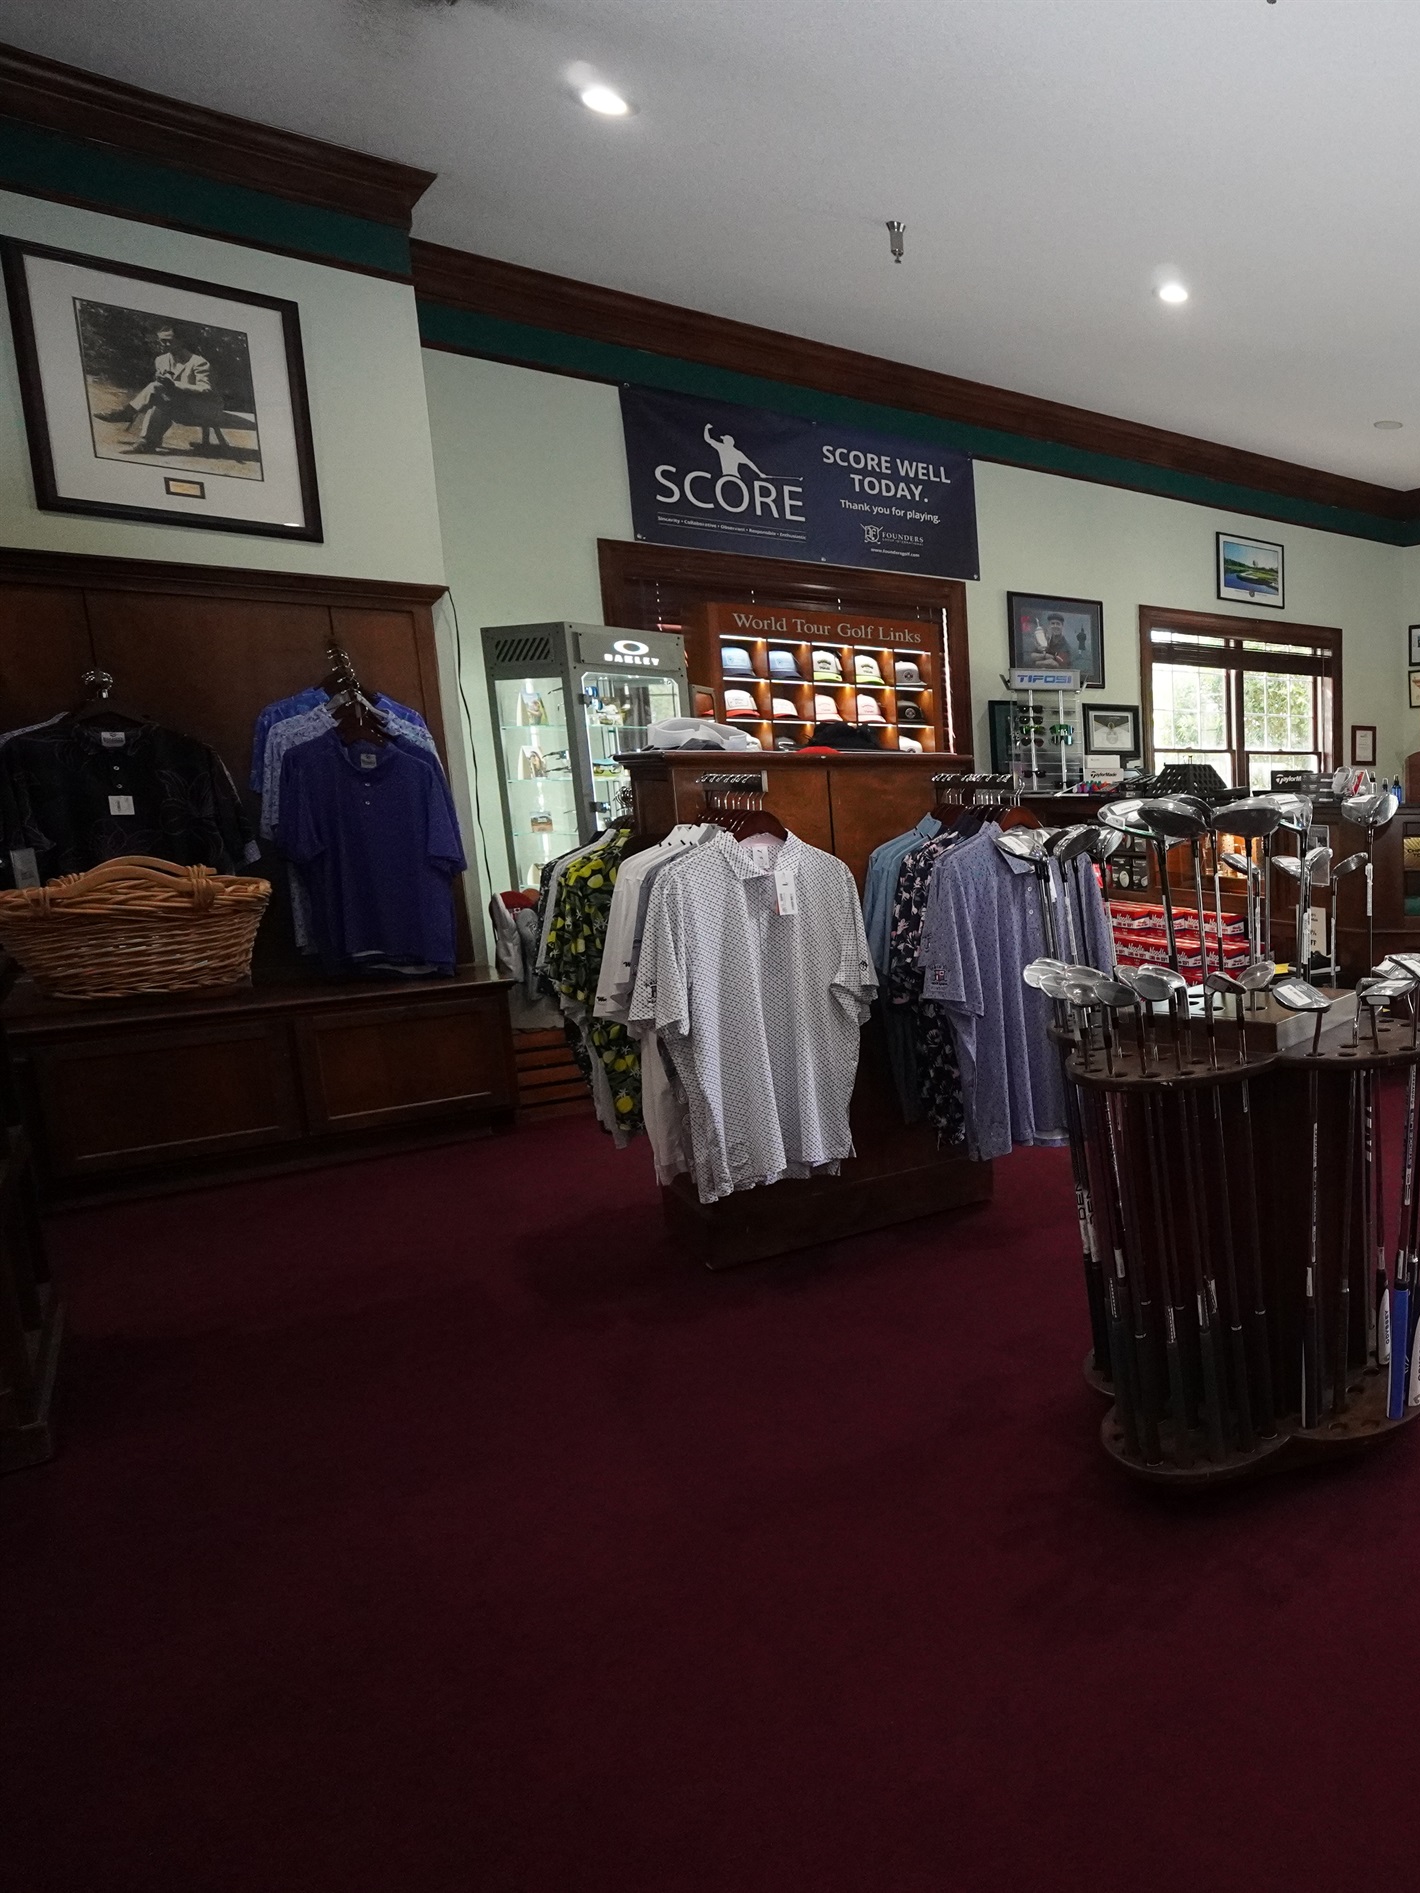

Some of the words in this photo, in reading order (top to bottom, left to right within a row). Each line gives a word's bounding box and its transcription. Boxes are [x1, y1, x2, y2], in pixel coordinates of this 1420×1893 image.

[822, 445, 892, 474] SCORE
[896, 458, 951, 484] WELL
[654, 464, 806, 522] SCORE
[850, 474, 929, 502] TODAY.
[840, 499, 870, 512] Thank
[872, 505, 890, 514] you
[892, 507, 904, 517] for
[907, 510, 941, 524] playing.
[657, 516, 680, 524] Sincerity
[684, 519, 717, 529] Collaborative
[720, 524, 745, 532] Observant
[749, 528, 776, 536] Responsible
[882, 531, 924, 543] FOUNDERS
[733, 612, 787, 632] World
[792, 618, 831, 636] Tour
[836, 623, 873, 639] Golf
[878, 627, 922, 644] Links
[604, 653, 659, 666] OAKLEY
[1017, 674, 1072, 684] TIFOSI
[1276, 774, 1301, 784] TaylorM
[1151, 914, 1166, 923] Noodl
[1128, 943, 1144, 952] Noodle
[1149, 946, 1166, 955] Noodle
